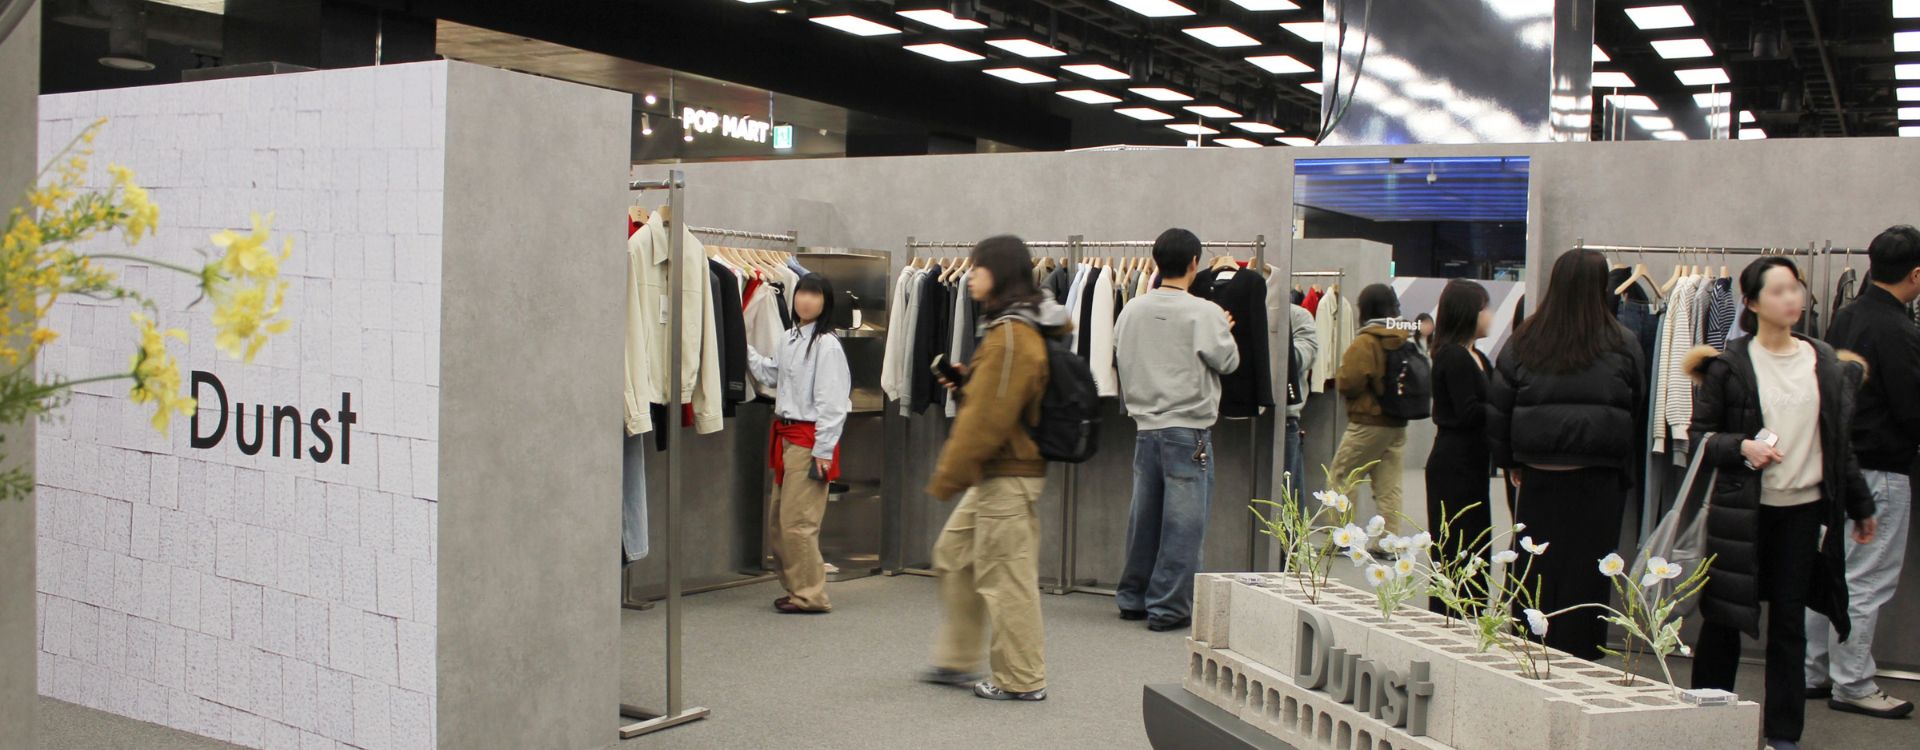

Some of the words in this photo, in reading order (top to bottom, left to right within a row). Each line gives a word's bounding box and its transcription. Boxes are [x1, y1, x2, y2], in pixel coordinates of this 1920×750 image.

[683, 107, 719, 133] POP
[722, 114, 770, 143] MART
[1386, 317, 1422, 331] Dunst
[190, 370, 357, 465] Dunst
[1294, 609, 1434, 736] Dunst
